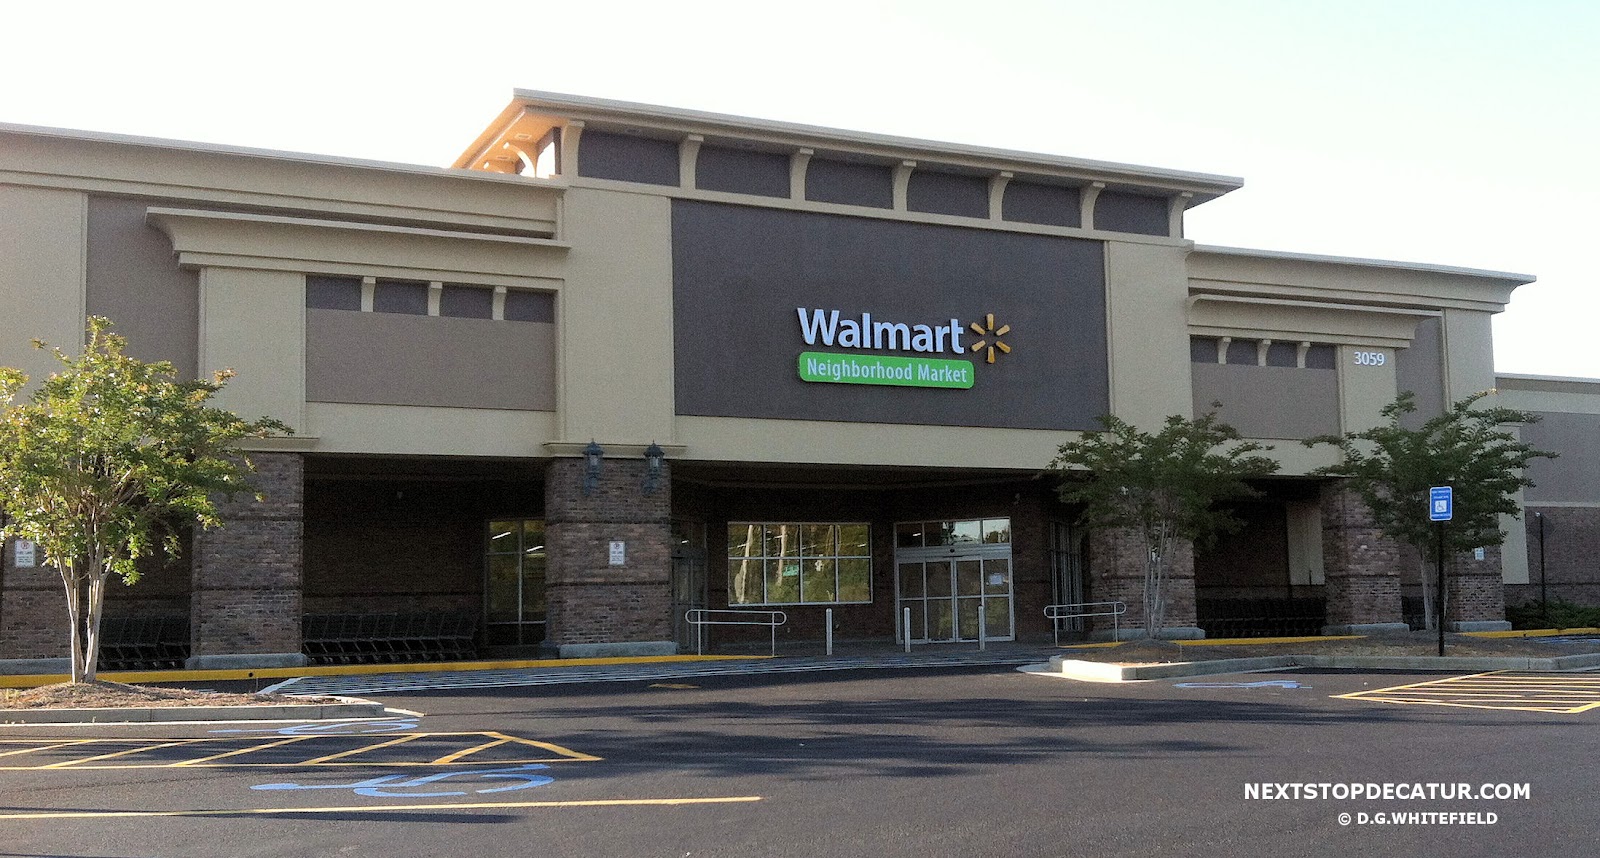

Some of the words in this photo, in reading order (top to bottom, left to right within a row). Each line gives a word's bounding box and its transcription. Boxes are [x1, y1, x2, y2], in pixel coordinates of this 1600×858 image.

[797, 307, 965, 354] Walmart
[807, 357, 913, 380] Neighborhood
[918, 363, 967, 383] Market
[1354, 351, 1385, 366] 3059
